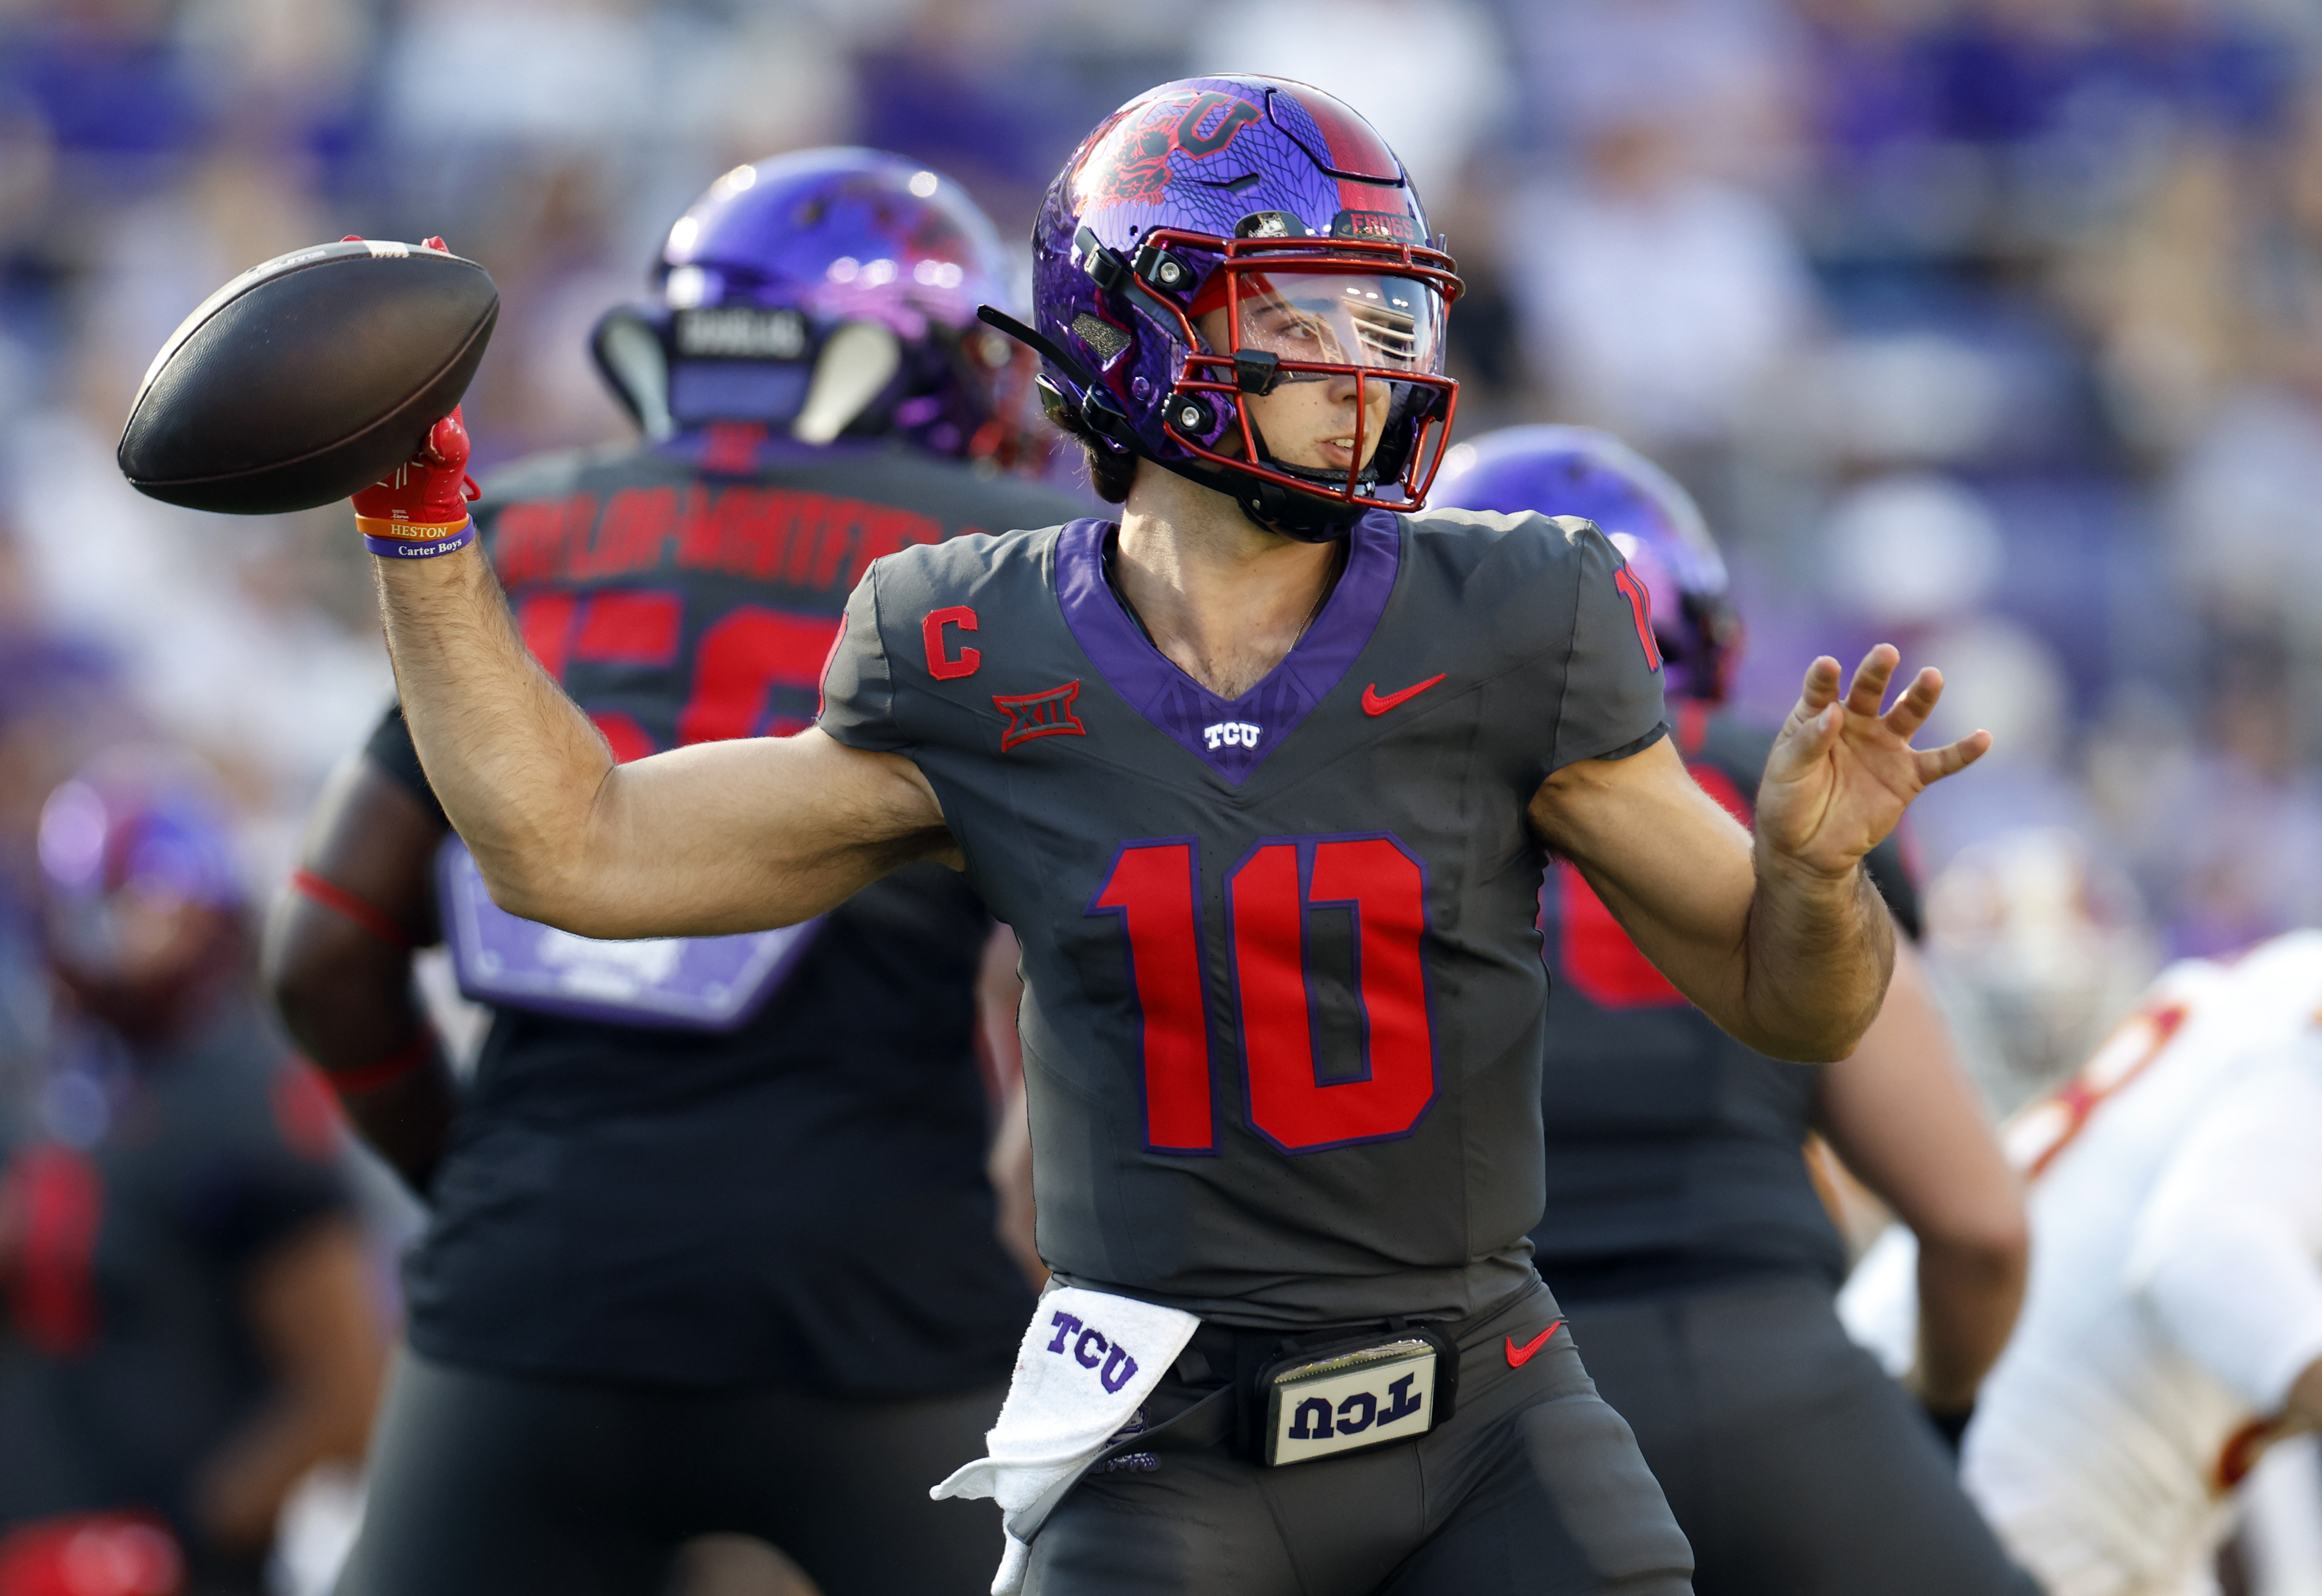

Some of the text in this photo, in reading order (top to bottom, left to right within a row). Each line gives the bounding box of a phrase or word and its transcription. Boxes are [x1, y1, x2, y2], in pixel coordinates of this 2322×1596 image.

[1349, 213, 1415, 240] FROGS
[390, 523, 448, 538] HESTON
[398, 538, 463, 556] Carter Boys
[922, 605, 981, 680] C
[998, 685, 1081, 746] XII
[1203, 721, 1261, 750] TCU
[1083, 829, 1443, 1157] 10
[1047, 1311, 1139, 1395] TCU
[1288, 1371, 1422, 1440] TCU
